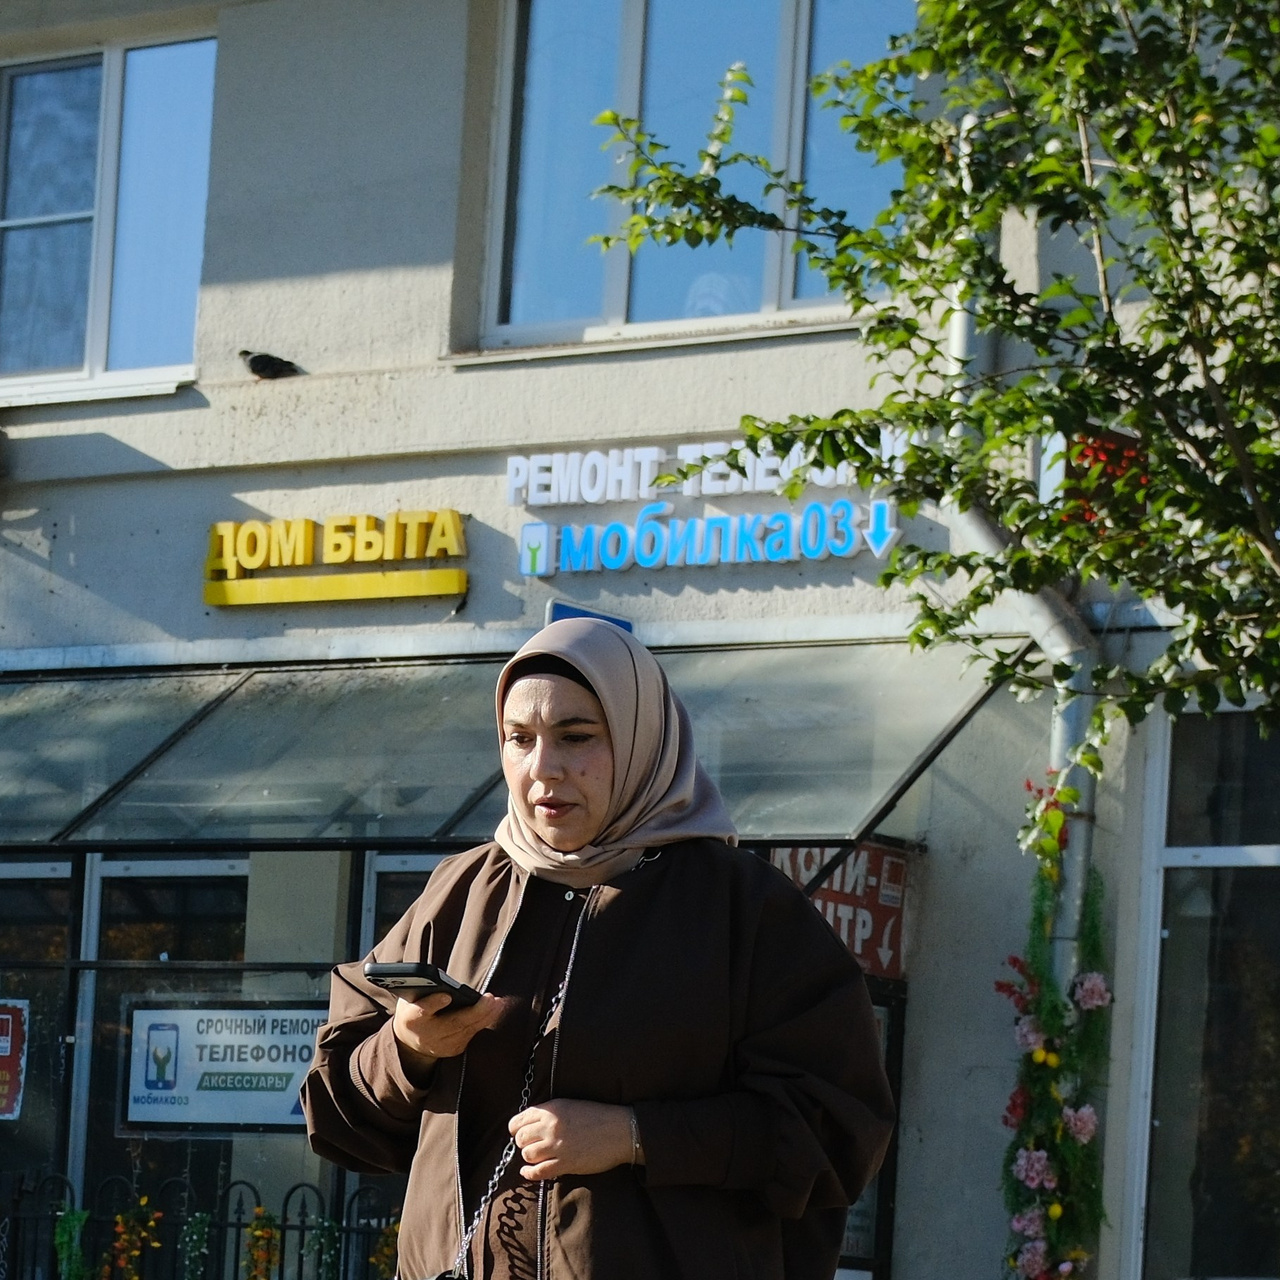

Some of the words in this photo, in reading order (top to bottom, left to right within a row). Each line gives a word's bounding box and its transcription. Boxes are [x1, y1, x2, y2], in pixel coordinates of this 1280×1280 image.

[507, 446, 666, 506] РЕМОНТ
[206, 518, 312, 581] ДОМ
[322, 508, 464, 565] БЫТА
[558, 499, 860, 571] мобилка03
[196, 1015, 266, 1035] СРОЧНЫЙ
[271, 1018, 328, 1035] РЕМОН
[196, 1044, 313, 1063] ТЕЛЕФОНО
[201, 1075, 287, 1089] АКСЕССУАРЫ
